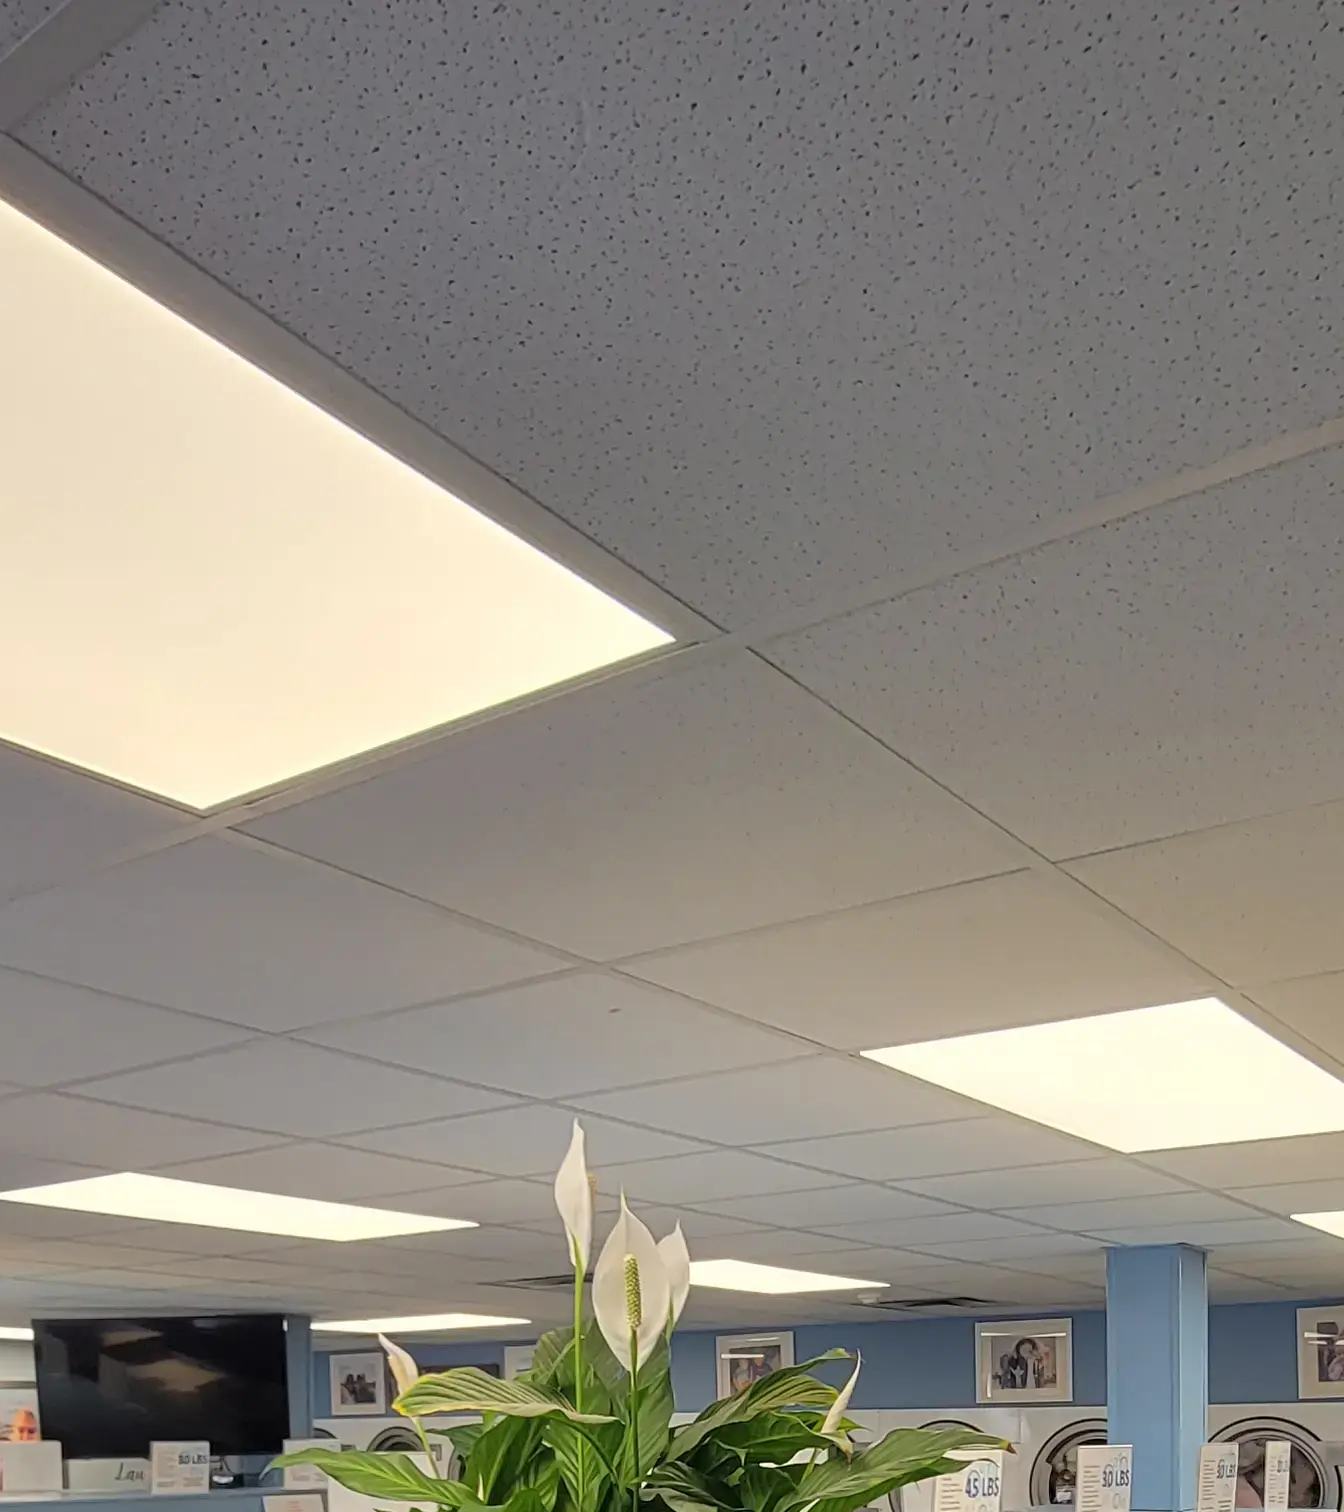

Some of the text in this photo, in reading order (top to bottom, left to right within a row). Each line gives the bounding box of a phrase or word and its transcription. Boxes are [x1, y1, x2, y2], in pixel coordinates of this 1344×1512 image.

[965, 1477, 999, 1498] 45 LBS
[1102, 1469, 1130, 1488] 30 LBS
